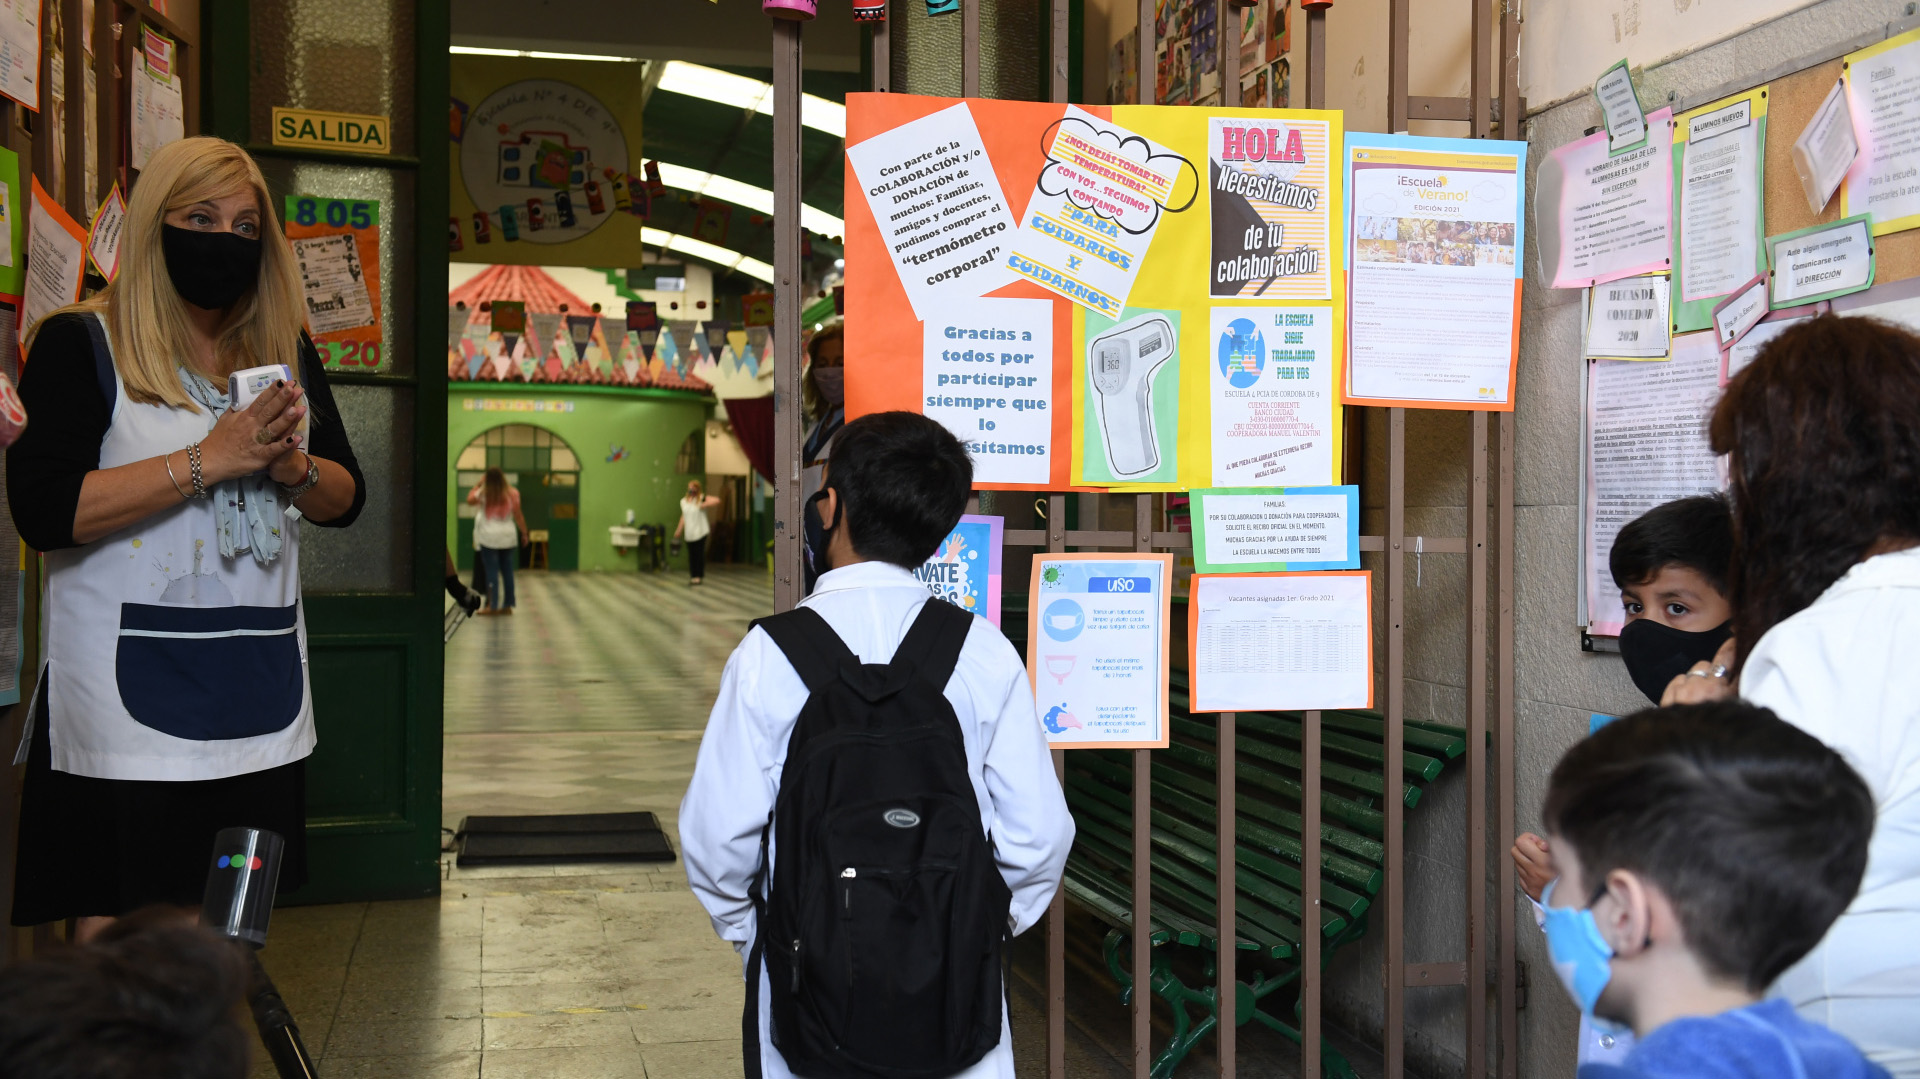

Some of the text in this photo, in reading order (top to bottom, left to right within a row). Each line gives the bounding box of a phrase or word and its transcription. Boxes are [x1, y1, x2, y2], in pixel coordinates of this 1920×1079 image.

[1693, 110, 1744, 133] ALUMNOS NUEVOS
[279, 116, 383, 146] SALIDA
[1222, 126, 1305, 163] HOLA
[880, 141, 960, 176] Con parte de la
[1592, 161, 1613, 172] HORARIO
[1621, 153, 1638, 164] SALIDA
[1647, 147, 1656, 156] LOS
[1643, 161, 1650, 169] HS
[870, 149, 980, 196] COLABORACIÓN y/o
[1074, 154, 1146, 193] TEMPERATURA?
[1118, 159, 1152, 180] TOMAR
[1152, 174, 1166, 186] TU
[1869, 168, 1916, 186] Para la escuela
[892, 169, 969, 204] DONACIÓN de
[1057, 166, 1077, 180] CON
[1104, 186, 1150, 213] SEGUIMOS
[1217, 166, 1318, 211] Necesitamos
[1398, 175, 1443, 188] ¡Escuela
[1403, 188, 1468, 202] de Verano!
[1900, 187, 1906, 196] la
[890, 181, 984, 221] muchos: Familias,
[1073, 189, 1123, 216] CONTANDO
[296, 199, 371, 229] 8 05
[894, 194, 991, 236] amigos y docentes,
[894, 203, 1001, 253] pudimos comprar el
[1244, 222, 1283, 251] de tu
[1031, 216, 1131, 269] CUIDARLOS
[1820, 235, 1852, 250] emergente
[1067, 256, 1082, 270] Y
[1217, 244, 1318, 283] colaboración
[1792, 256, 1832, 271] Comunicarse
[1805, 268, 1841, 284] DIRECCIÓN
[1609, 288, 1655, 301] BECAS DE
[1275, 313, 1313, 326] LA ESCUELA
[1607, 308, 1653, 321] COMEDOR
[944, 326, 1032, 341] Gracias a
[1284, 332, 1303, 344] SIGUE
[1618, 330, 1639, 342] 2020
[339, 339, 381, 367] 20
[941, 350, 1034, 366] todos por
[1272, 349, 1315, 362] TRABAJANDO
[937, 372, 1037, 388] participar
[1277, 367, 1309, 379] PARA VOS
[926, 394, 1046, 411] siempre que
[978, 418, 996, 431] lo
[965, 441, 1045, 455] esitamos
[1270, 466, 1286, 474] GRACIAS
[913, 563, 959, 582] AVATE
[927, 584, 941, 594] AS
